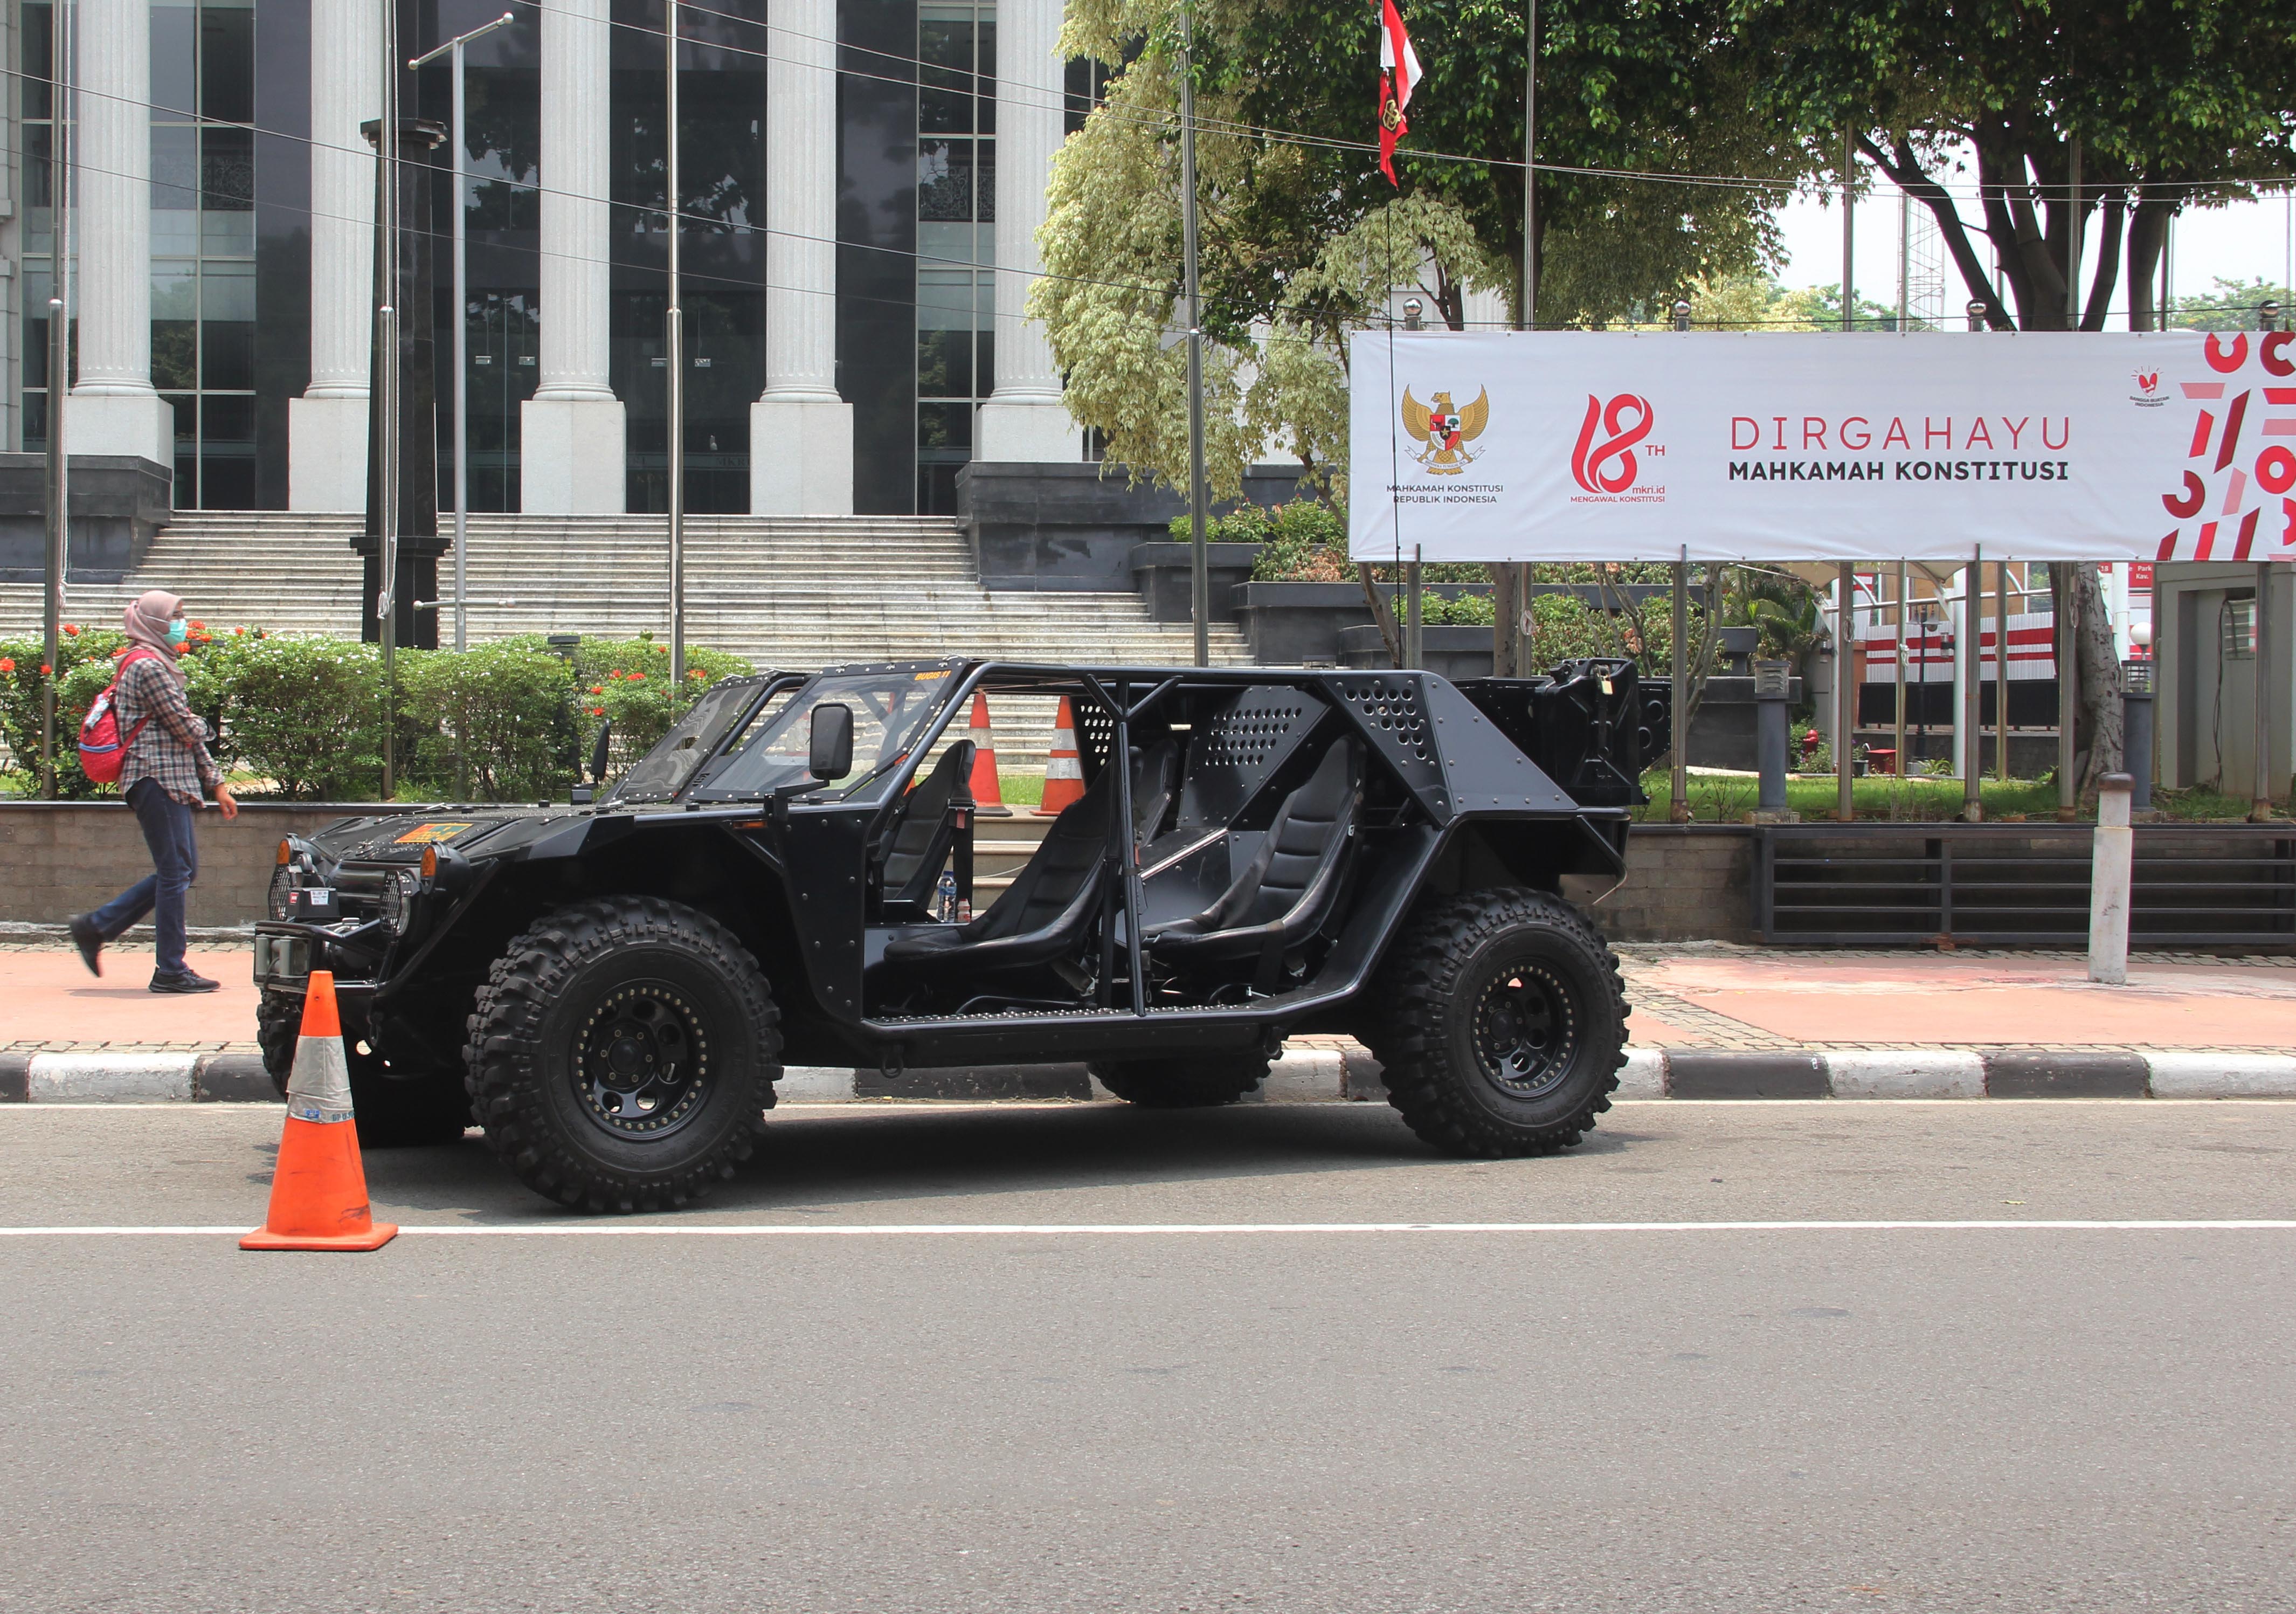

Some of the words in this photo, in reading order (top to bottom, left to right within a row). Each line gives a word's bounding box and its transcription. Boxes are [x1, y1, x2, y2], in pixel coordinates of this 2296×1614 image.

[1731, 417, 2069, 450] DIRGAHAYU
[1645, 445, 1665, 456] TH
[1728, 461, 1883, 480] MAHKAMAH
[1896, 461, 2069, 480] KONSTITUSI
[1633, 486, 1665, 494] mkri.id
[915, 672, 941, 680] BUGIS
